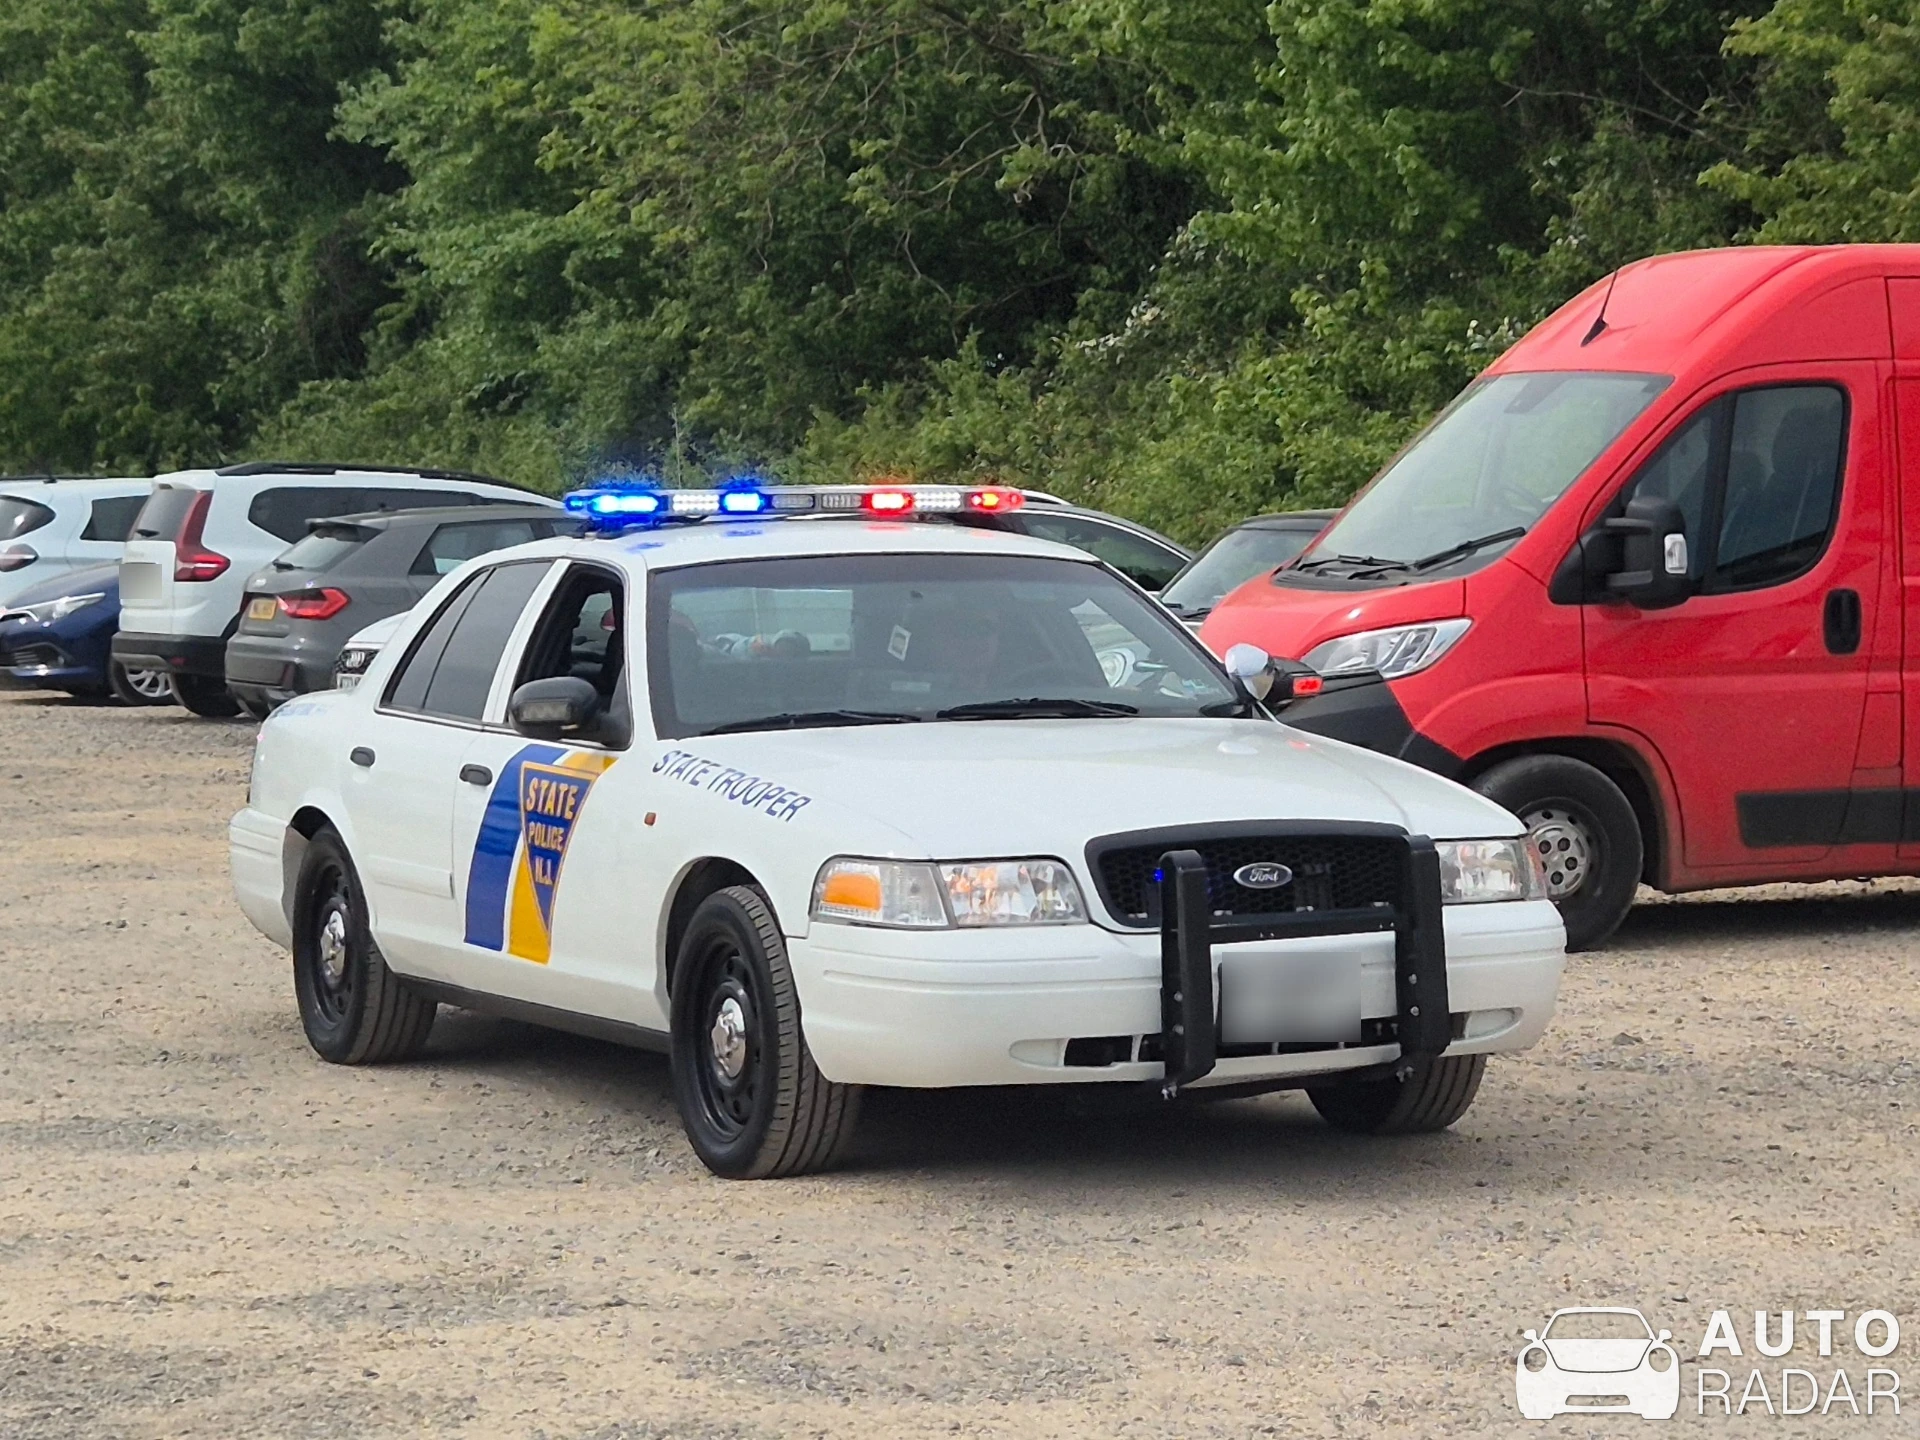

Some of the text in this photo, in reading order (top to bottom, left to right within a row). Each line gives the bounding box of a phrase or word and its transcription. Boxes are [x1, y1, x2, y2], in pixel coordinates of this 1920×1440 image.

[526, 777, 579, 820] STATE
[652, 749, 812, 822] STATE TROOPER
[528, 823, 565, 851] POLICE
[1249, 867, 1279, 883] Ford
